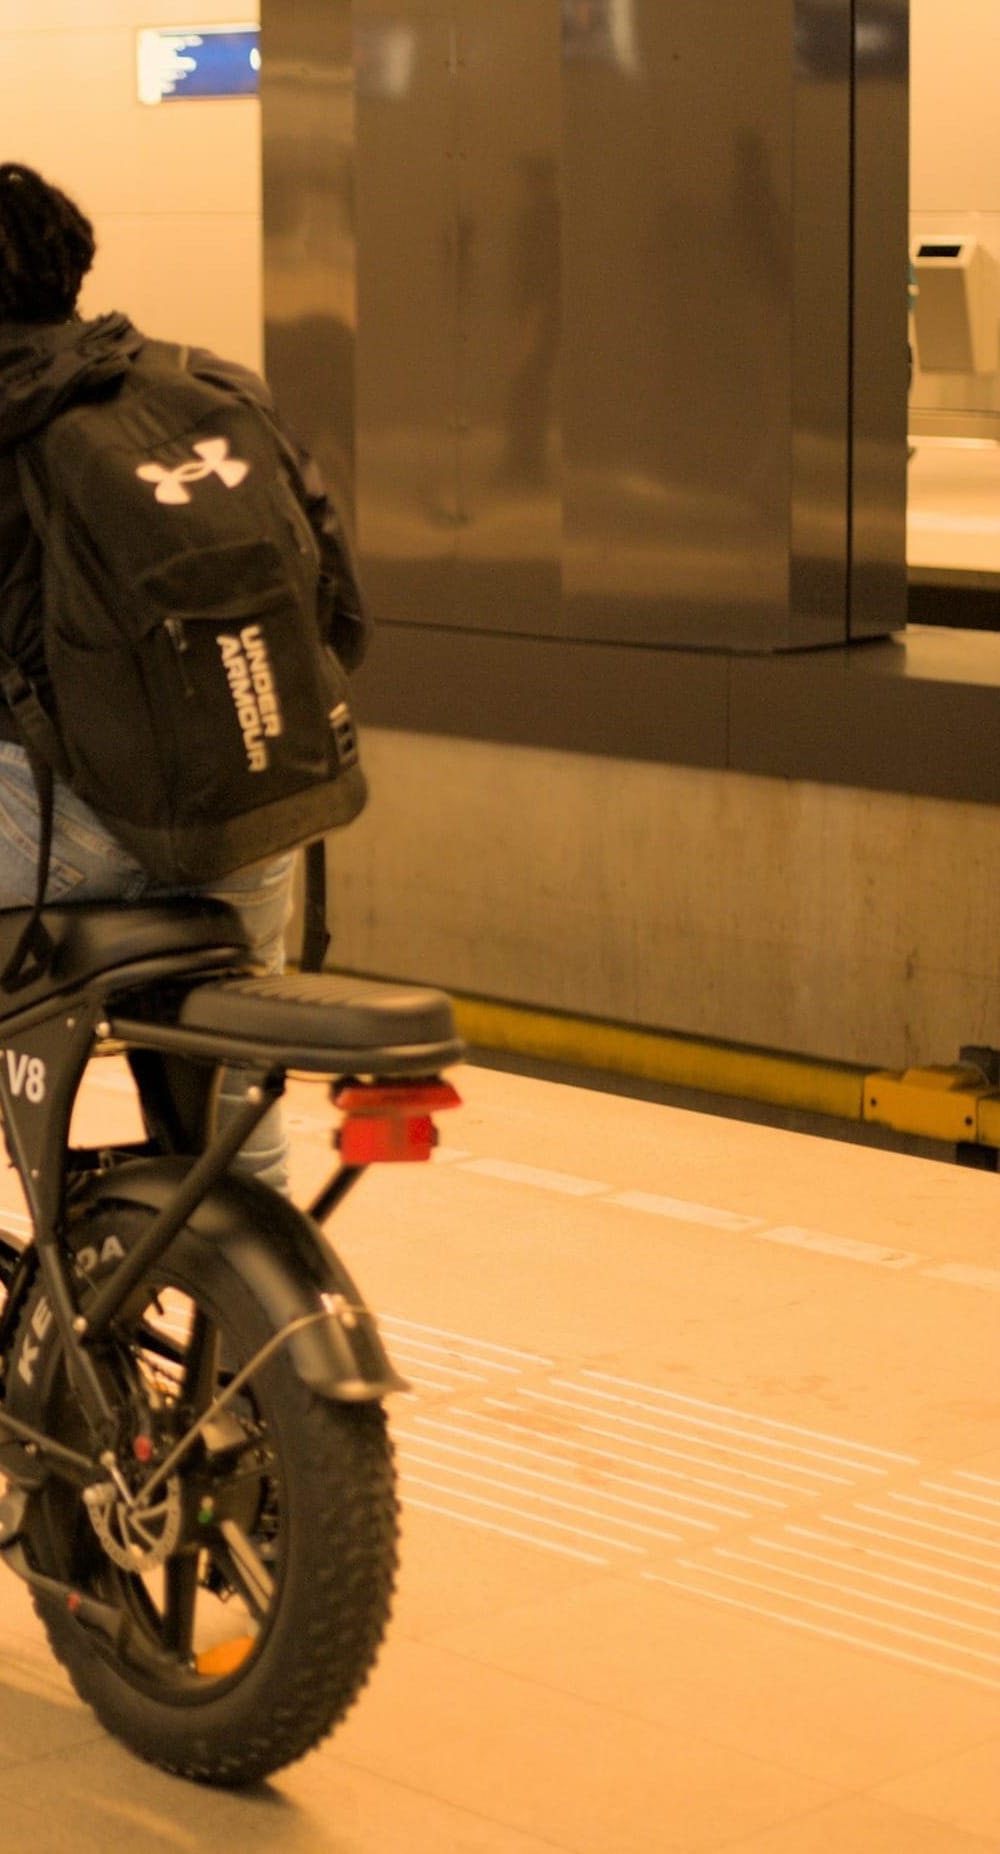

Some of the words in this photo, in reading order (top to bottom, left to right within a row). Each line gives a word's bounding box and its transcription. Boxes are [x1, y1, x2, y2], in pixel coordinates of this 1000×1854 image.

[216, 635, 268, 772] ARMOUR
[240, 624, 282, 737] UNDER
[6, 1049, 46, 1104] V8
[18, 1235, 124, 1385] KEDA
